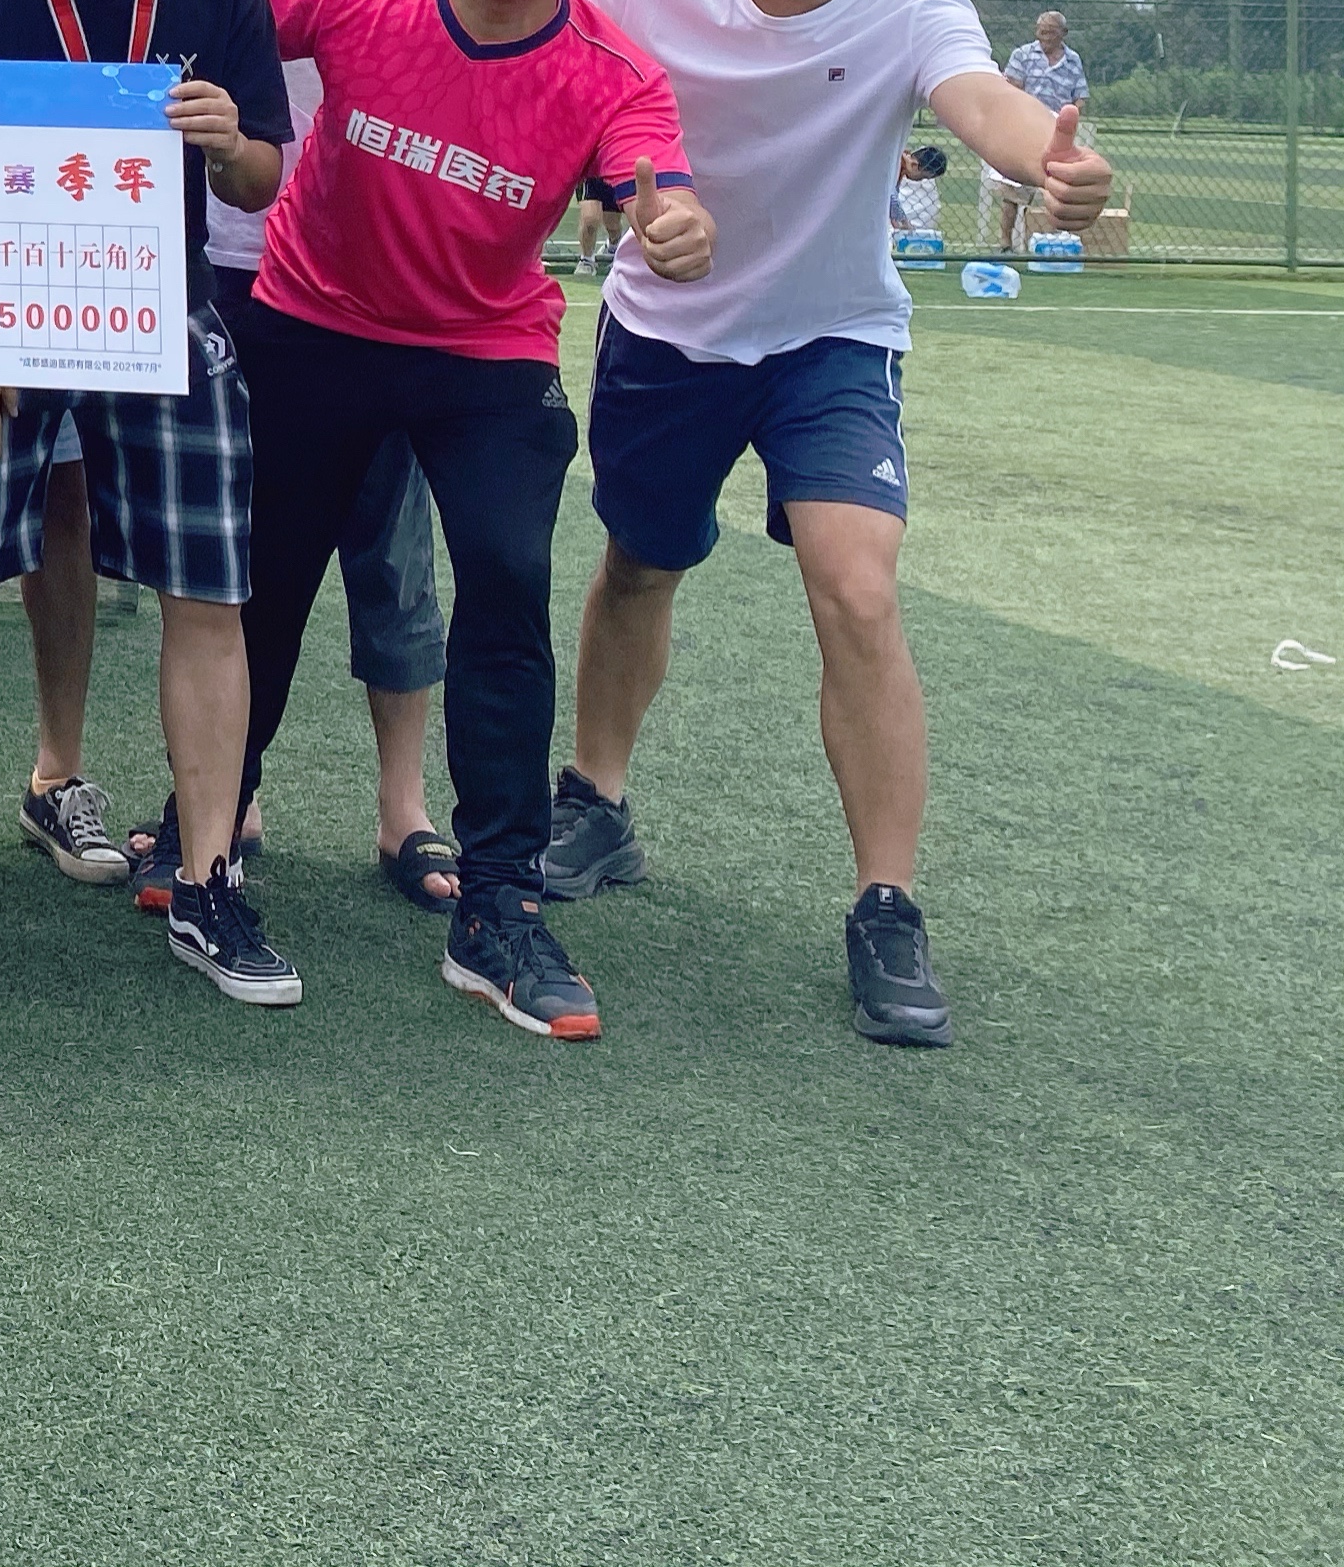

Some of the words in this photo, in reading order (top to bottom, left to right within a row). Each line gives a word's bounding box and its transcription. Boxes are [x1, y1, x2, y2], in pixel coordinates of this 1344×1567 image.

[55, 152, 154, 203] 季军
[346, 109, 535, 210] 恒瑞医药
